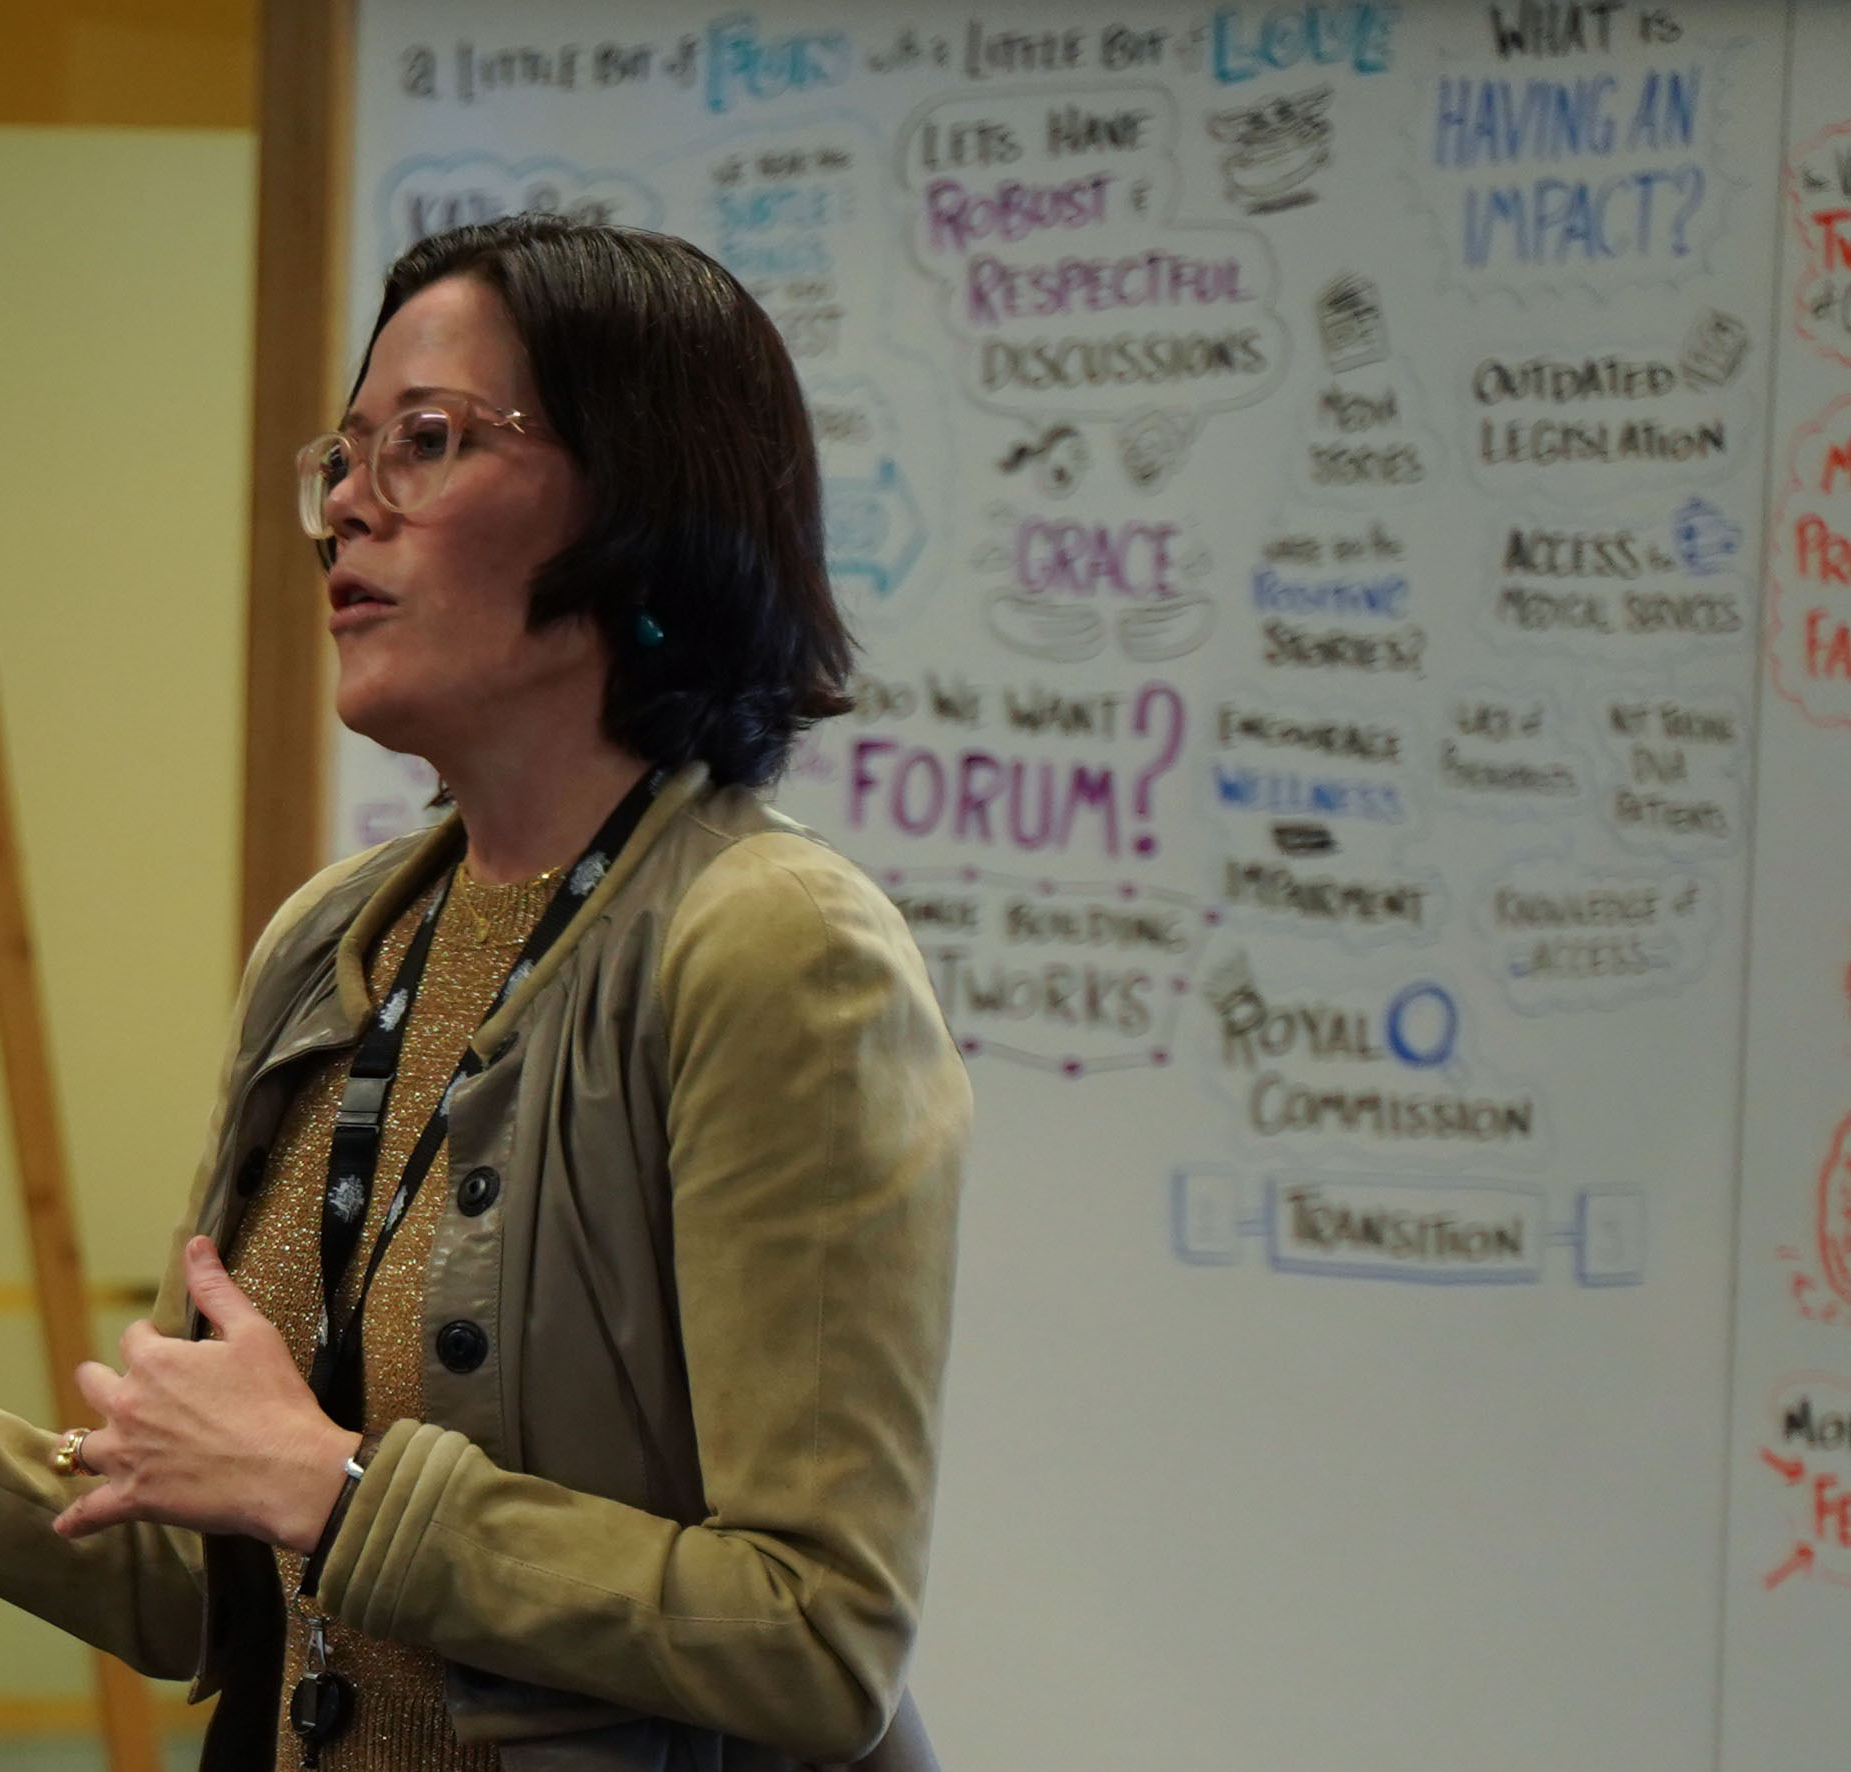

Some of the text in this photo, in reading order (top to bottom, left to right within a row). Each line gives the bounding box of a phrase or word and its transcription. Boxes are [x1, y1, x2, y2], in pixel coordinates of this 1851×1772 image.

[1490, 0, 1615, 62] WHAT
[1431, 63, 1702, 170] HAVING AN
[924, 173, 1114, 253] ROBUST
[1461, 166, 1708, 269] IMPACT?
[966, 249, 1254, 326] RESPECTFUL
[981, 328, 1269, 390] DISCUSSIONS
[1471, 355, 1677, 407] OUTDATED
[1478, 416, 1728, 467] LEGISLATION
[1016, 519, 1182, 598] GRACE
[1501, 523, 1642, 580] ACCESS
[933, 945, 1153, 1038] TWORKS
[1215, 990, 1387, 1072] ROYAL
[1248, 1070, 1536, 1142] COMMISSION
[1287, 1186, 1525, 1261] TRANSITION
